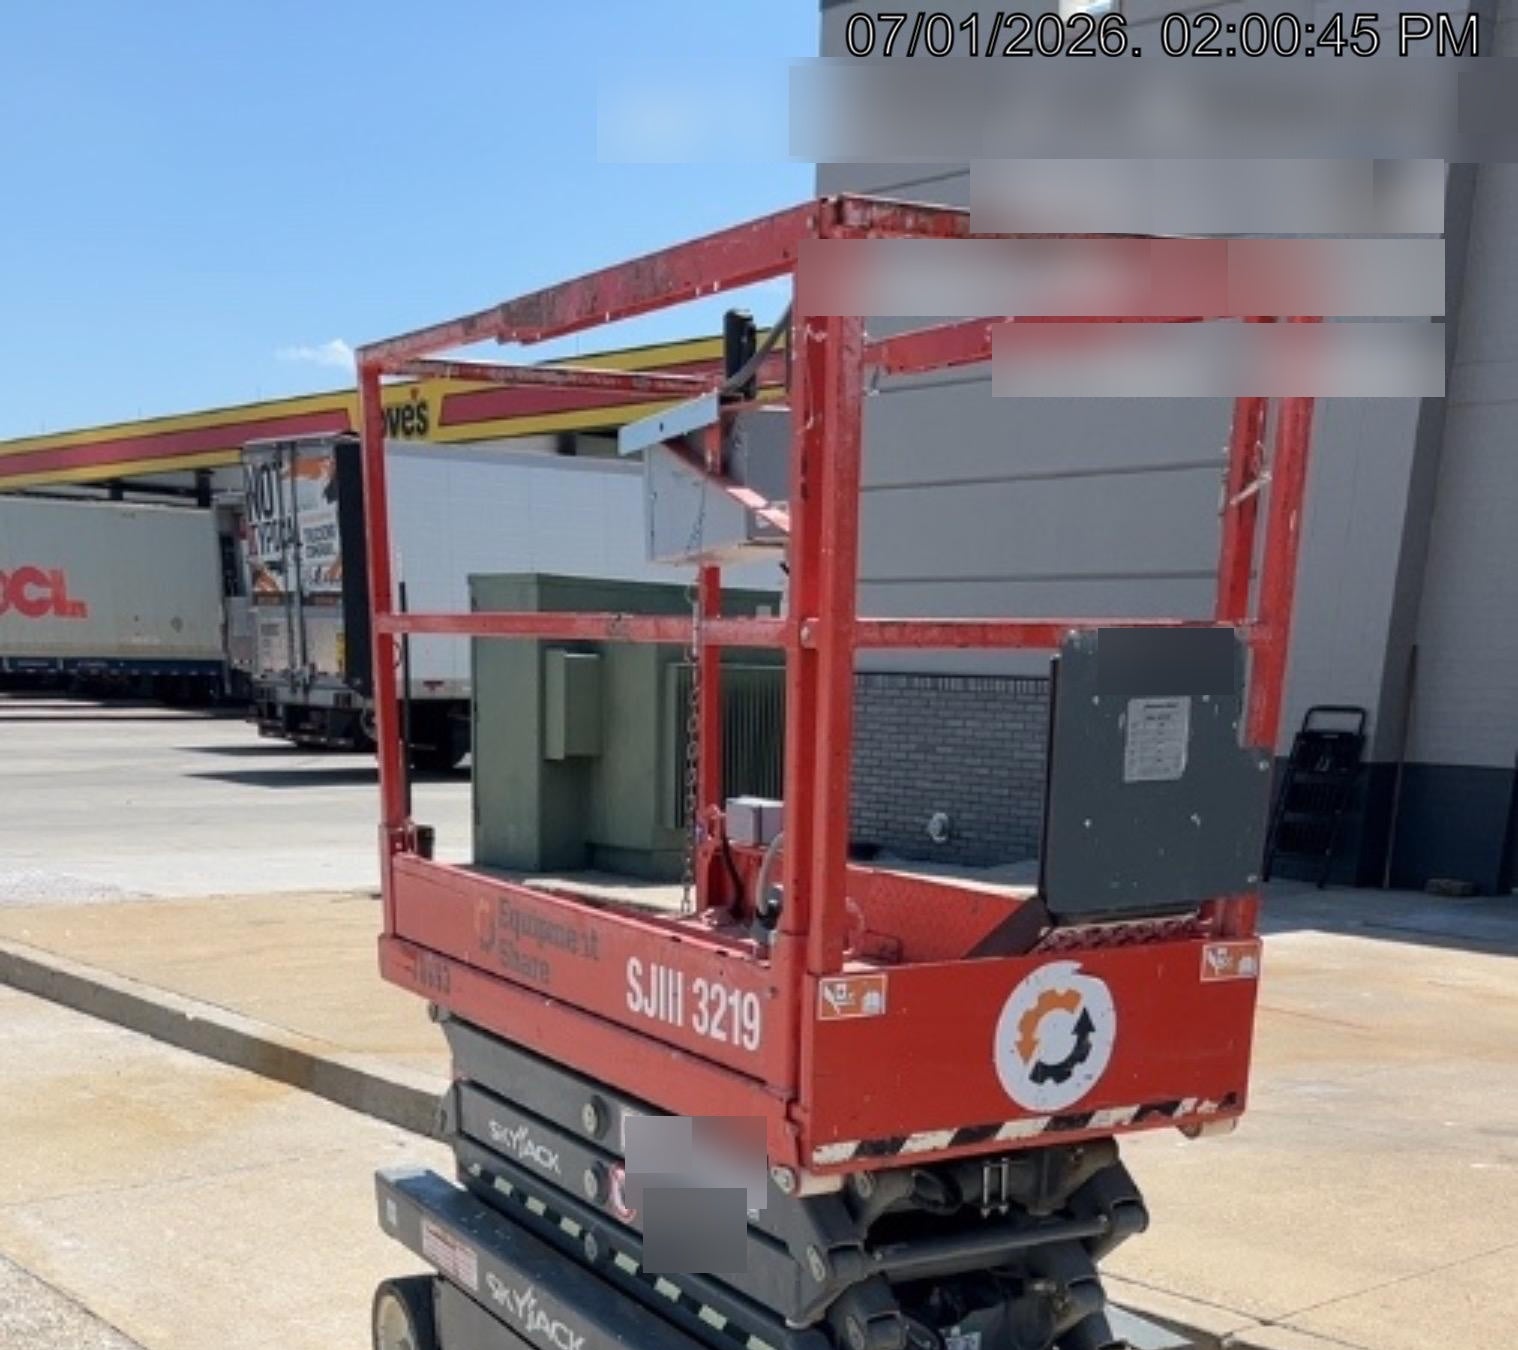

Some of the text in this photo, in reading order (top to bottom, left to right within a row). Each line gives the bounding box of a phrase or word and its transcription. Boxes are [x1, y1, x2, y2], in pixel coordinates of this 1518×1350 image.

[0, 565, 89, 620] CL
[692, 976, 761, 1051] 3219
[488, 1118, 561, 1174] SKYJACK
